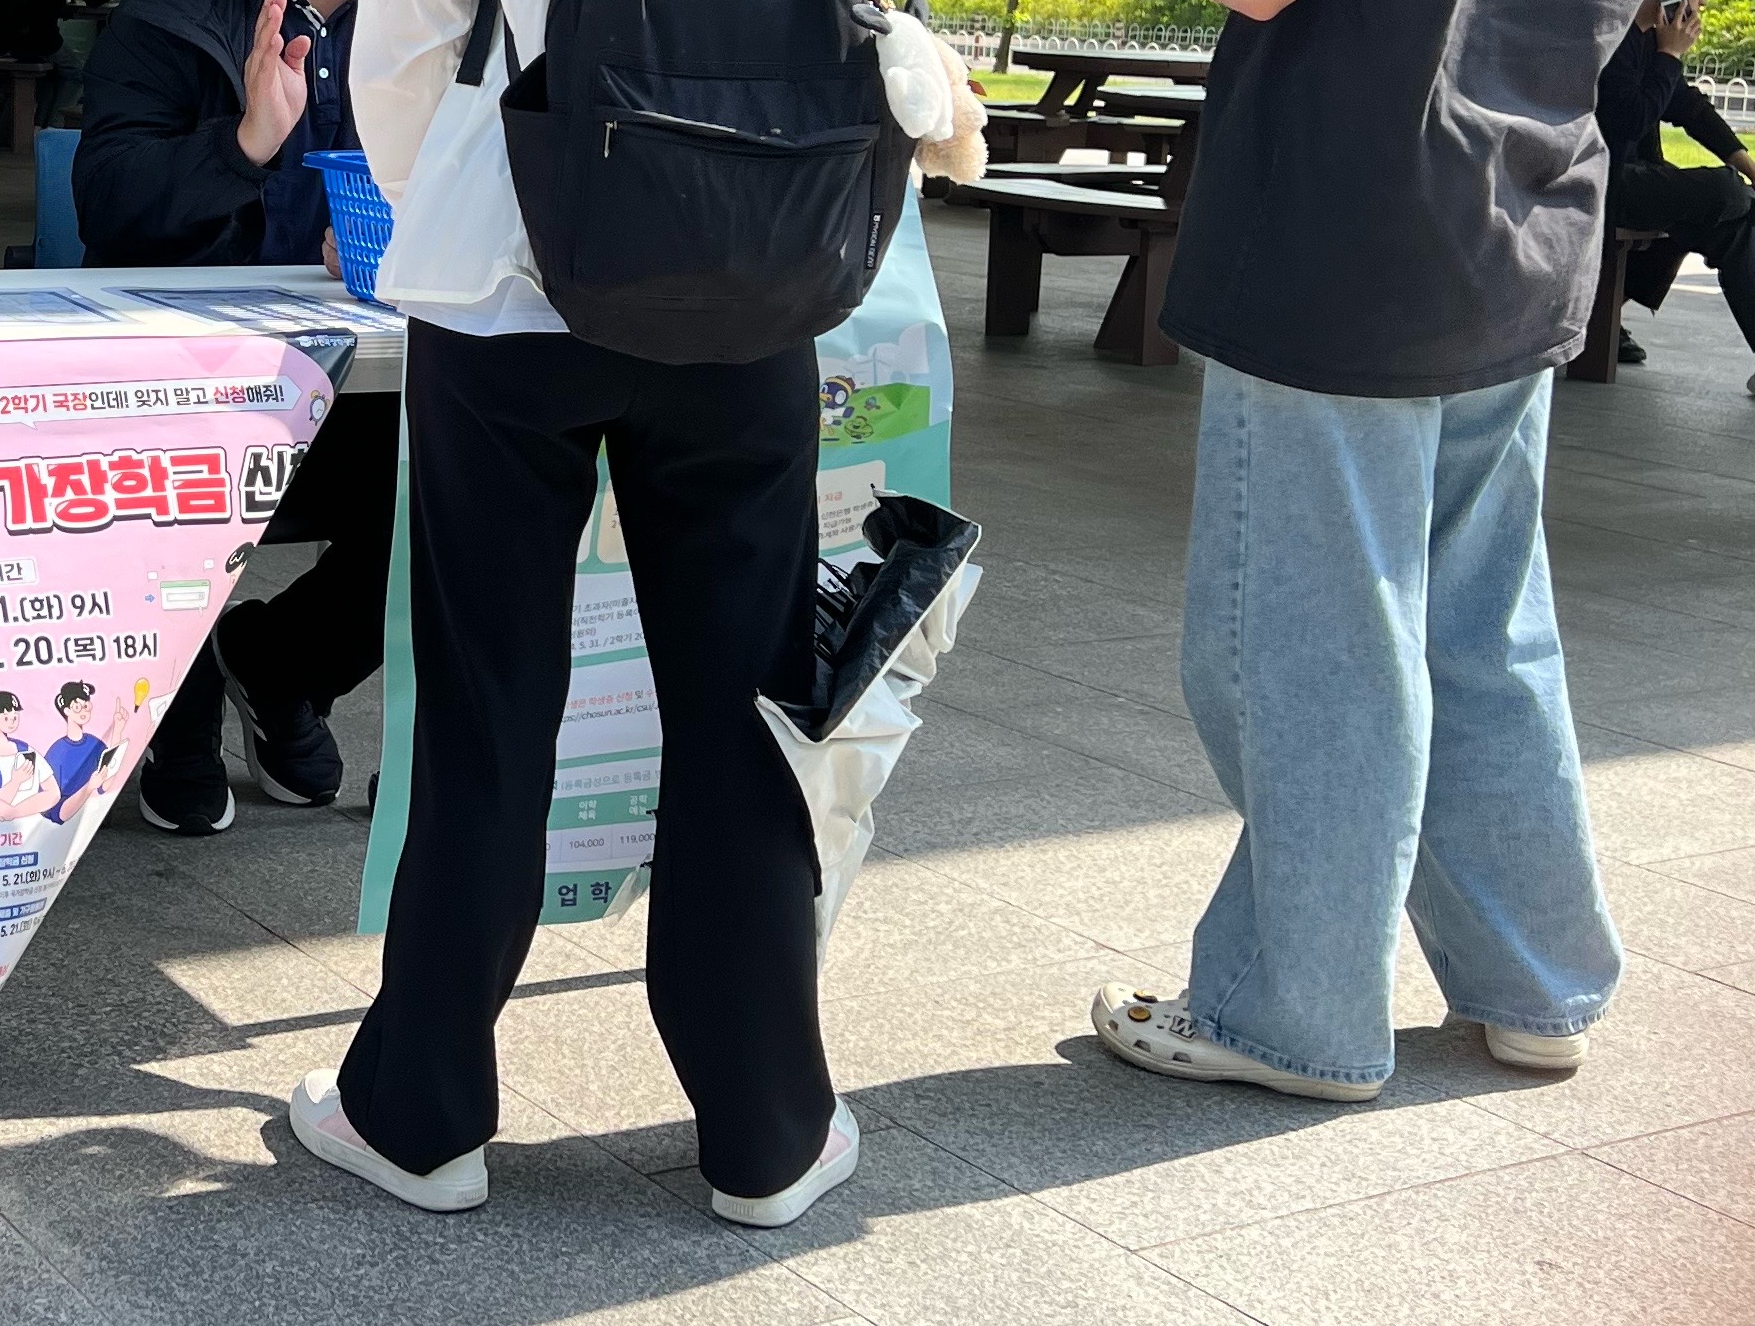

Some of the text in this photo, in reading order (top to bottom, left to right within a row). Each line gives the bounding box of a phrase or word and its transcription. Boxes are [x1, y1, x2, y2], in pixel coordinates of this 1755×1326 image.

[0, 393, 48, 415] 2학기
[52, 390, 129, 413] 국장인데!
[134, 388, 170, 408] 잊지
[173, 387, 209, 406] 말고
[213, 383, 285, 405] 신청해줘!
[70, 591, 111, 618] 9시
[13, 634, 107, 667] 20.(목)
[112, 632, 158, 659] 18시
[2, 873, 11, 887] 5.
